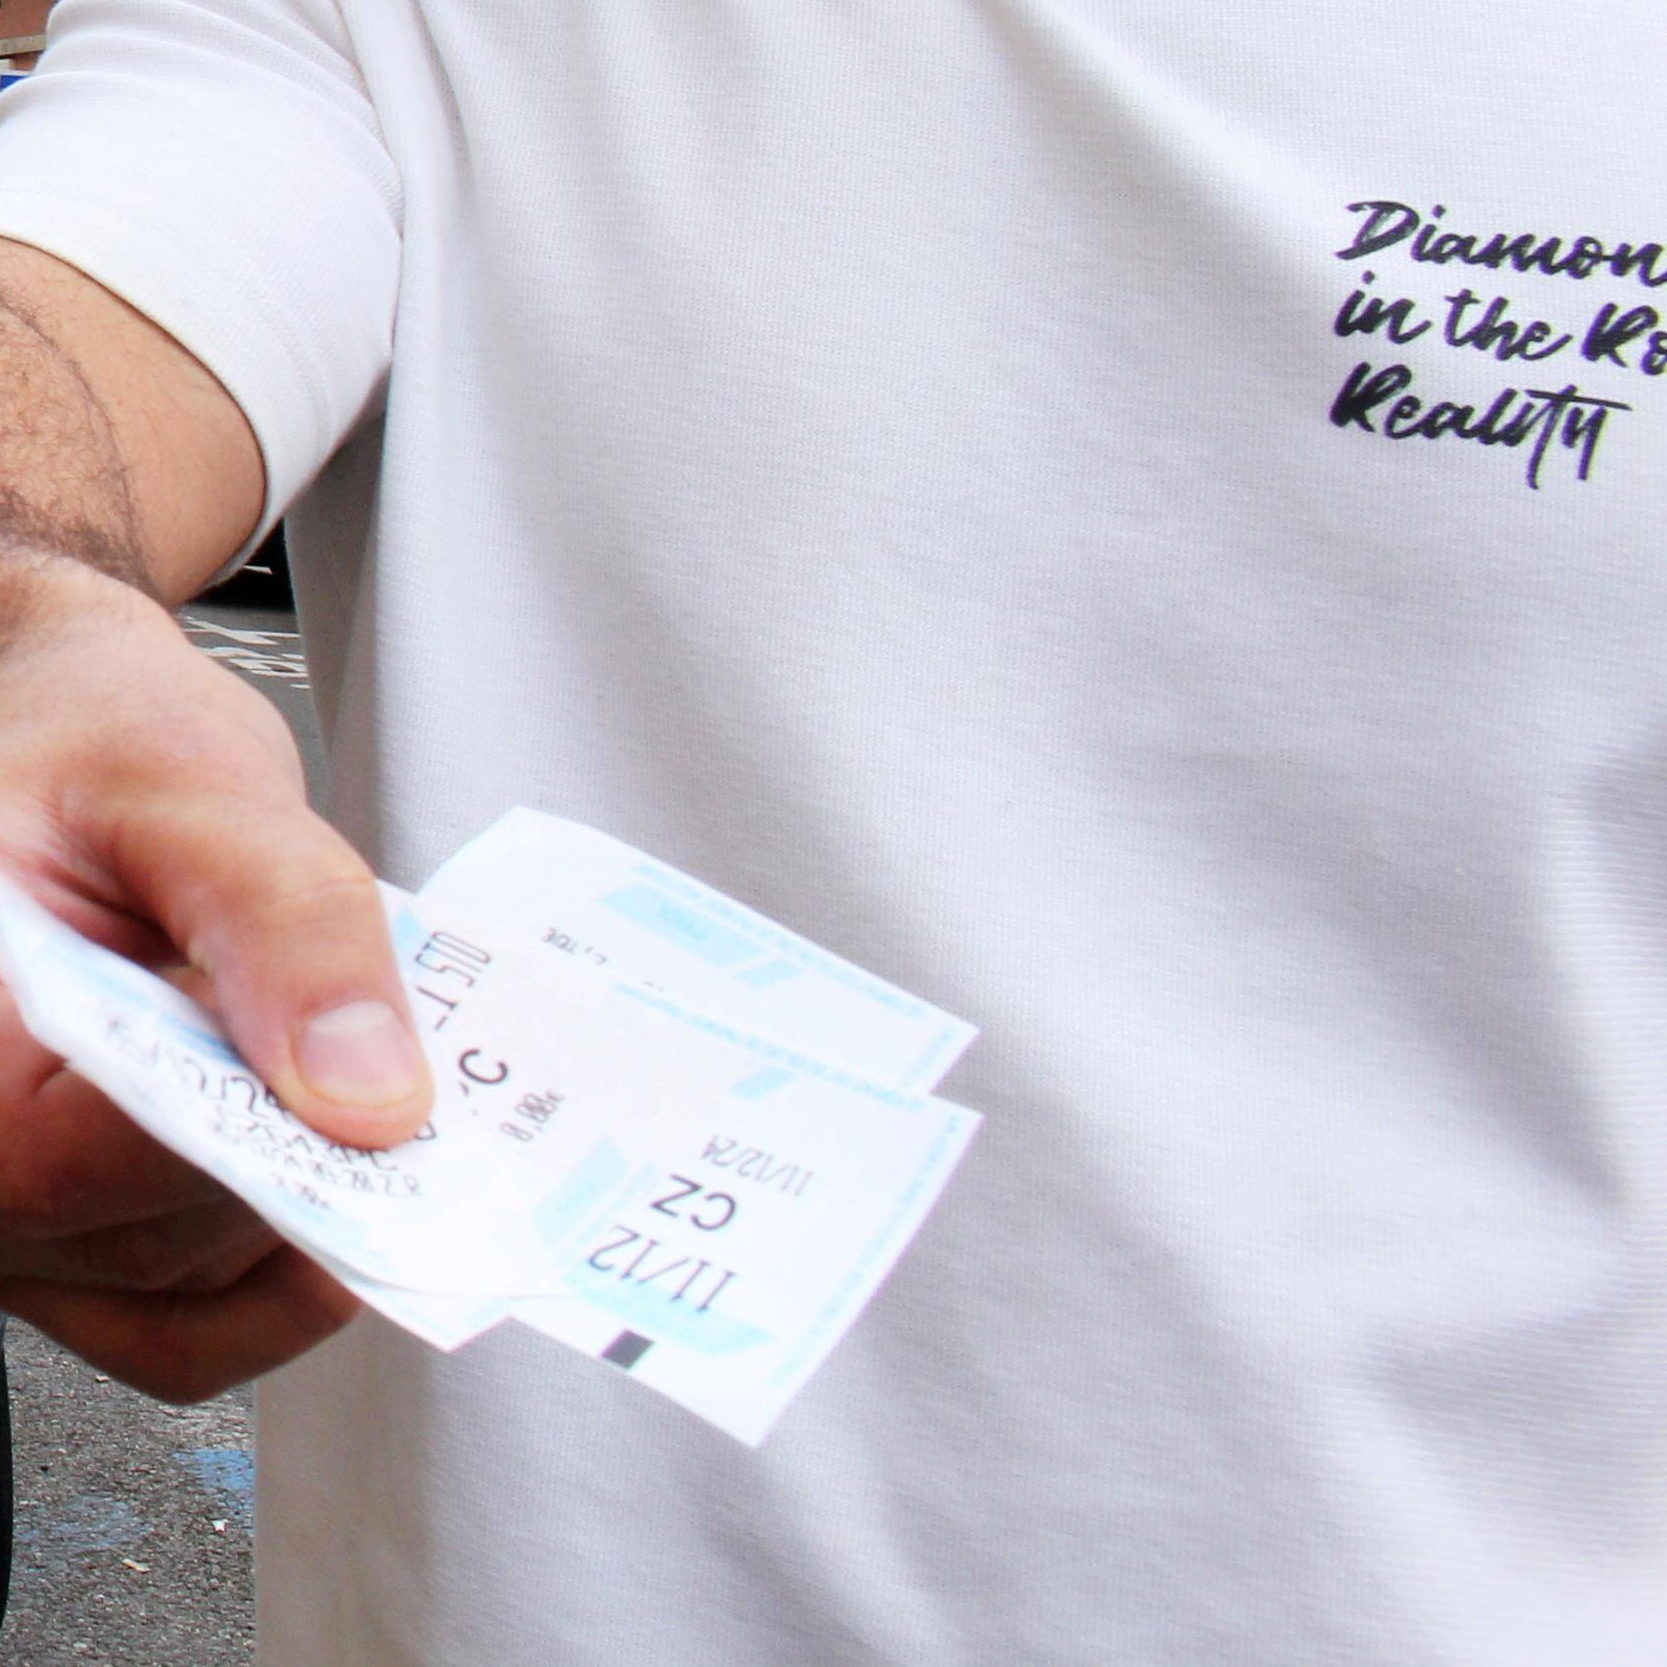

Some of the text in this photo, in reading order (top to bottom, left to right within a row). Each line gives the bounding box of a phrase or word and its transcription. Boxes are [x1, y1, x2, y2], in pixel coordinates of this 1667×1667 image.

[1333, 268, 1574, 362] in the
[1328, 360, 1633, 490] Reality
[582, 1223, 738, 1318] 11/12
